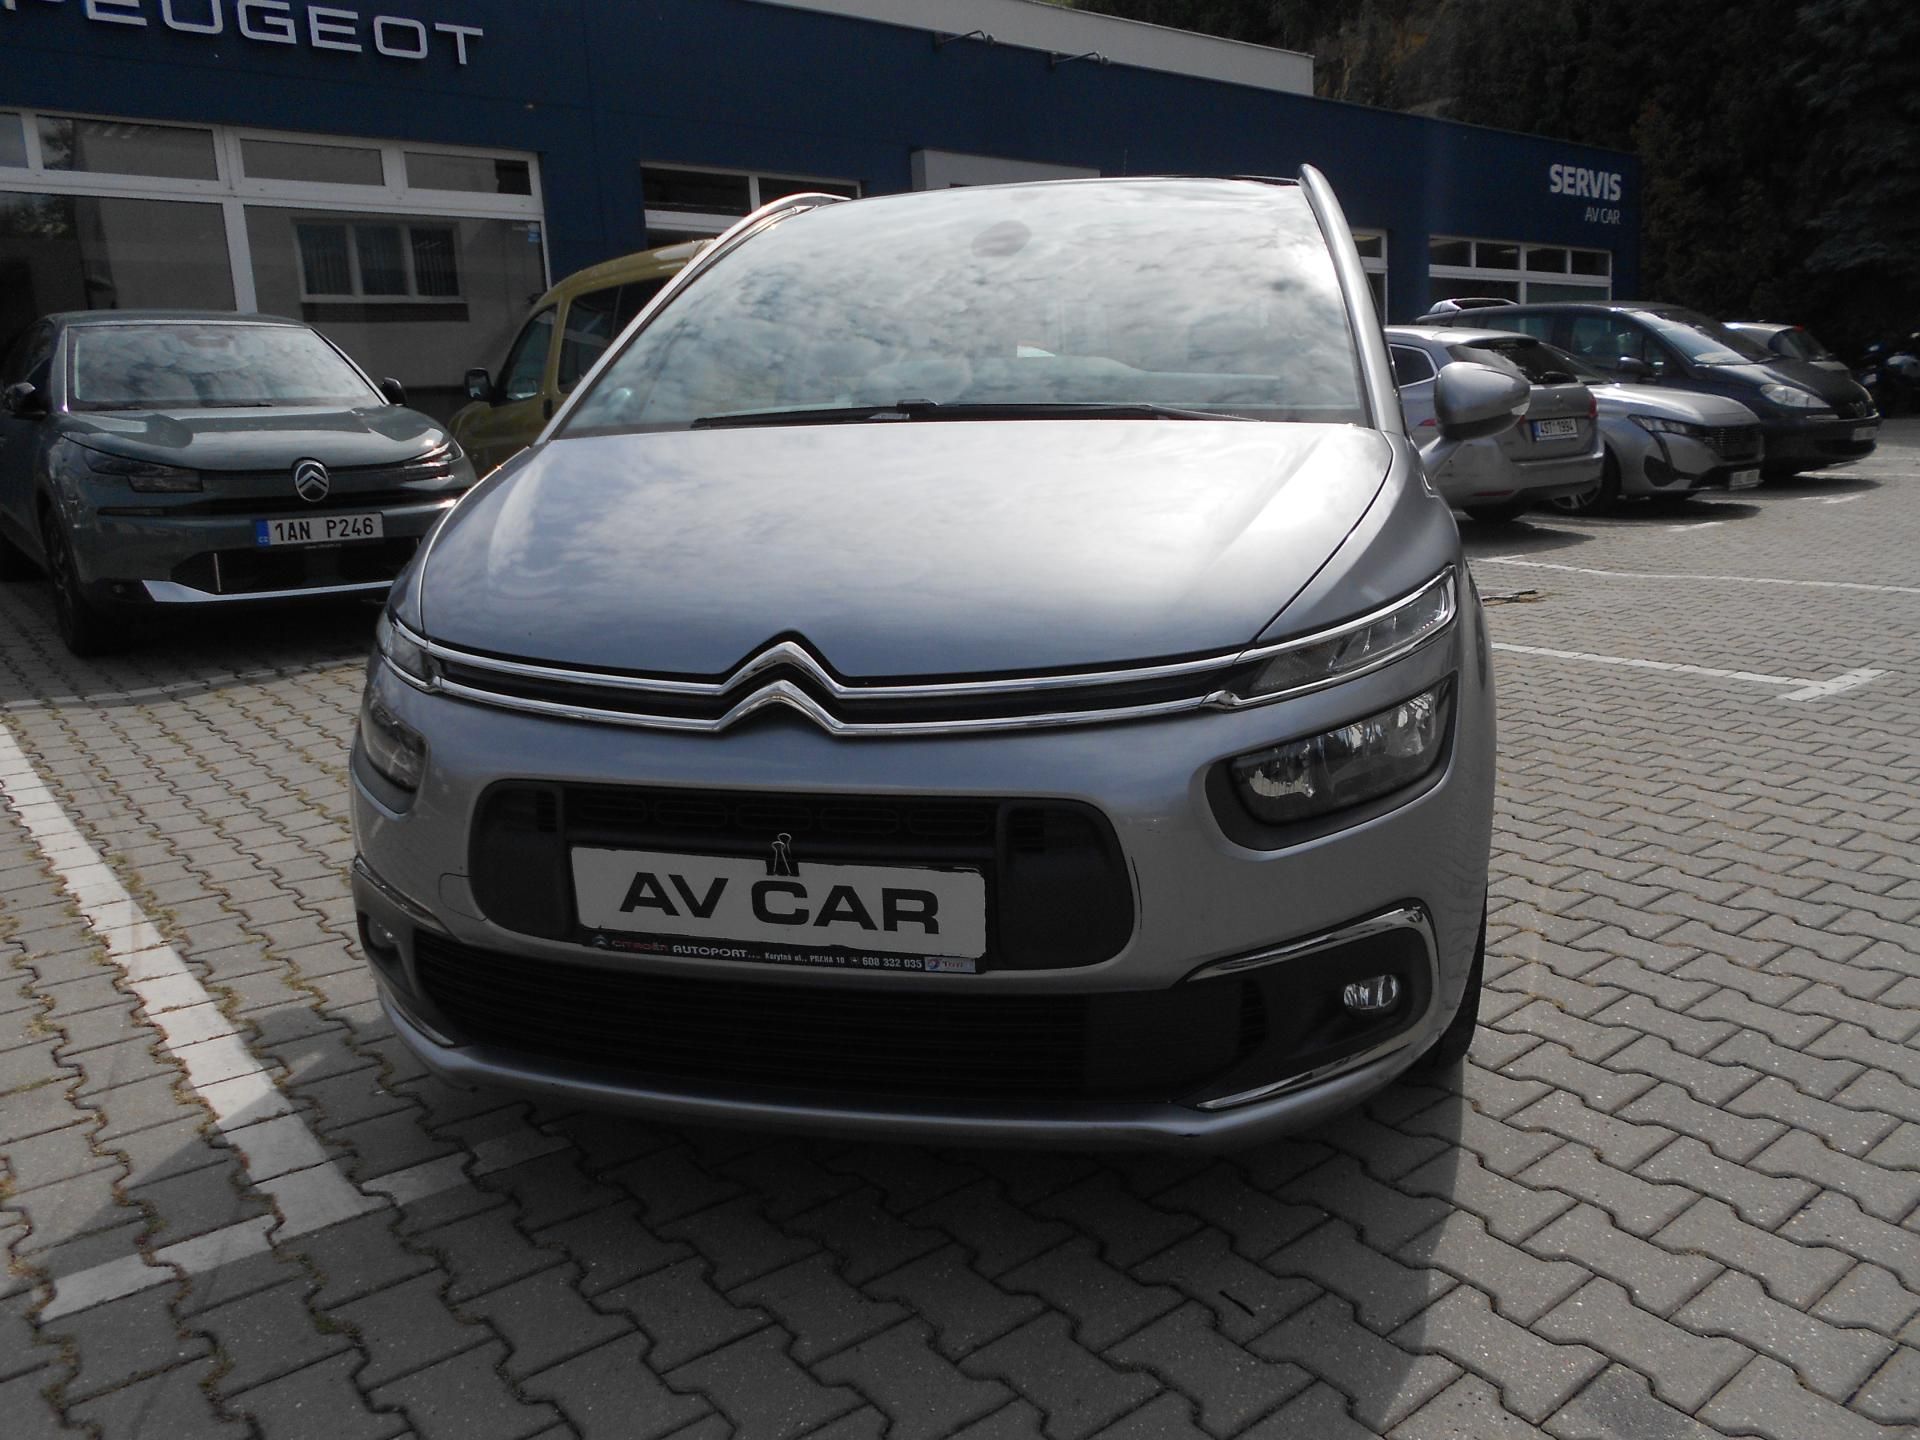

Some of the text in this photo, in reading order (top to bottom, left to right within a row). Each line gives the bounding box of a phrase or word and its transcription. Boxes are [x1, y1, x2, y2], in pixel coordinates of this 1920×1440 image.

[3, 0, 484, 65] EUGEOT
[1549, 163, 1622, 201] SERVIS
[1584, 206, 1621, 225] AV CAR
[274, 517, 374, 541] 1AN P246
[619, 871, 940, 935] AV CAR
[672, 944, 748, 958] AUTOPORT
[862, 956, 880, 967] 608
[883, 957, 901, 968] 332
[903, 958, 922, 969] 035
